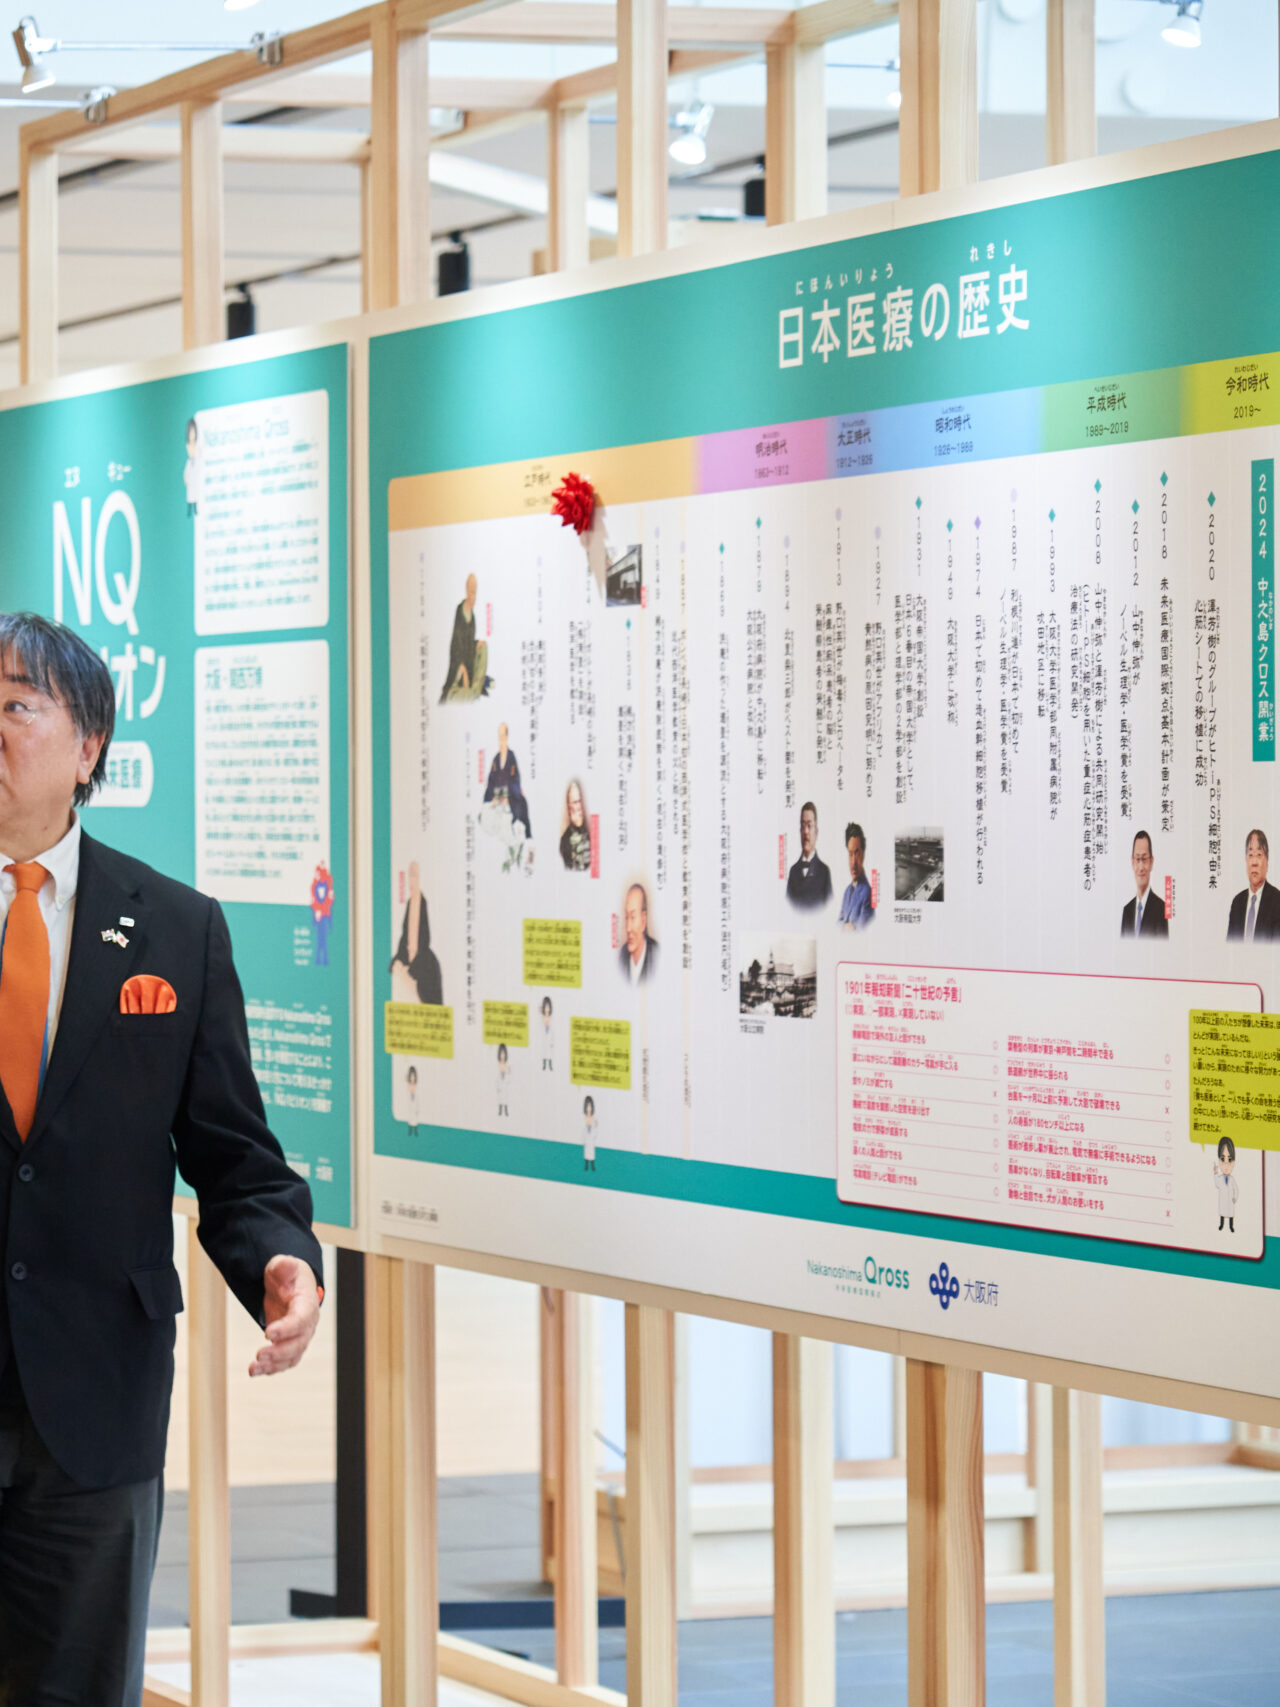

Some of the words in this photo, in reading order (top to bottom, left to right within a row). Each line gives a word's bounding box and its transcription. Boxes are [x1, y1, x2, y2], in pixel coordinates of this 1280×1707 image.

[969, 241, 1013, 263] れきし
[796, 262, 895, 295] にほんいりょう
[778, 263, 1030, 369] 日本医療の歴史
[1225, 372, 1270, 396] 令和時代
[1086, 392, 1127, 414] 平成時代
[837, 429, 872, 447] 大正時代
[935, 413, 972, 434] 昭和時代
[1258, 473, 1268, 559] 2024
[53, 489, 141, 636] NQ
[1208, 514, 1216, 581] 2020
[1257, 577, 1269, 742] 中之島クロス開業
[99, 642, 166, 722] オン
[807, 1259, 863, 1283] Nakanoshima
[864, 1255, 910, 1291] Qross
[963, 1279, 999, 1308] 大阪府
